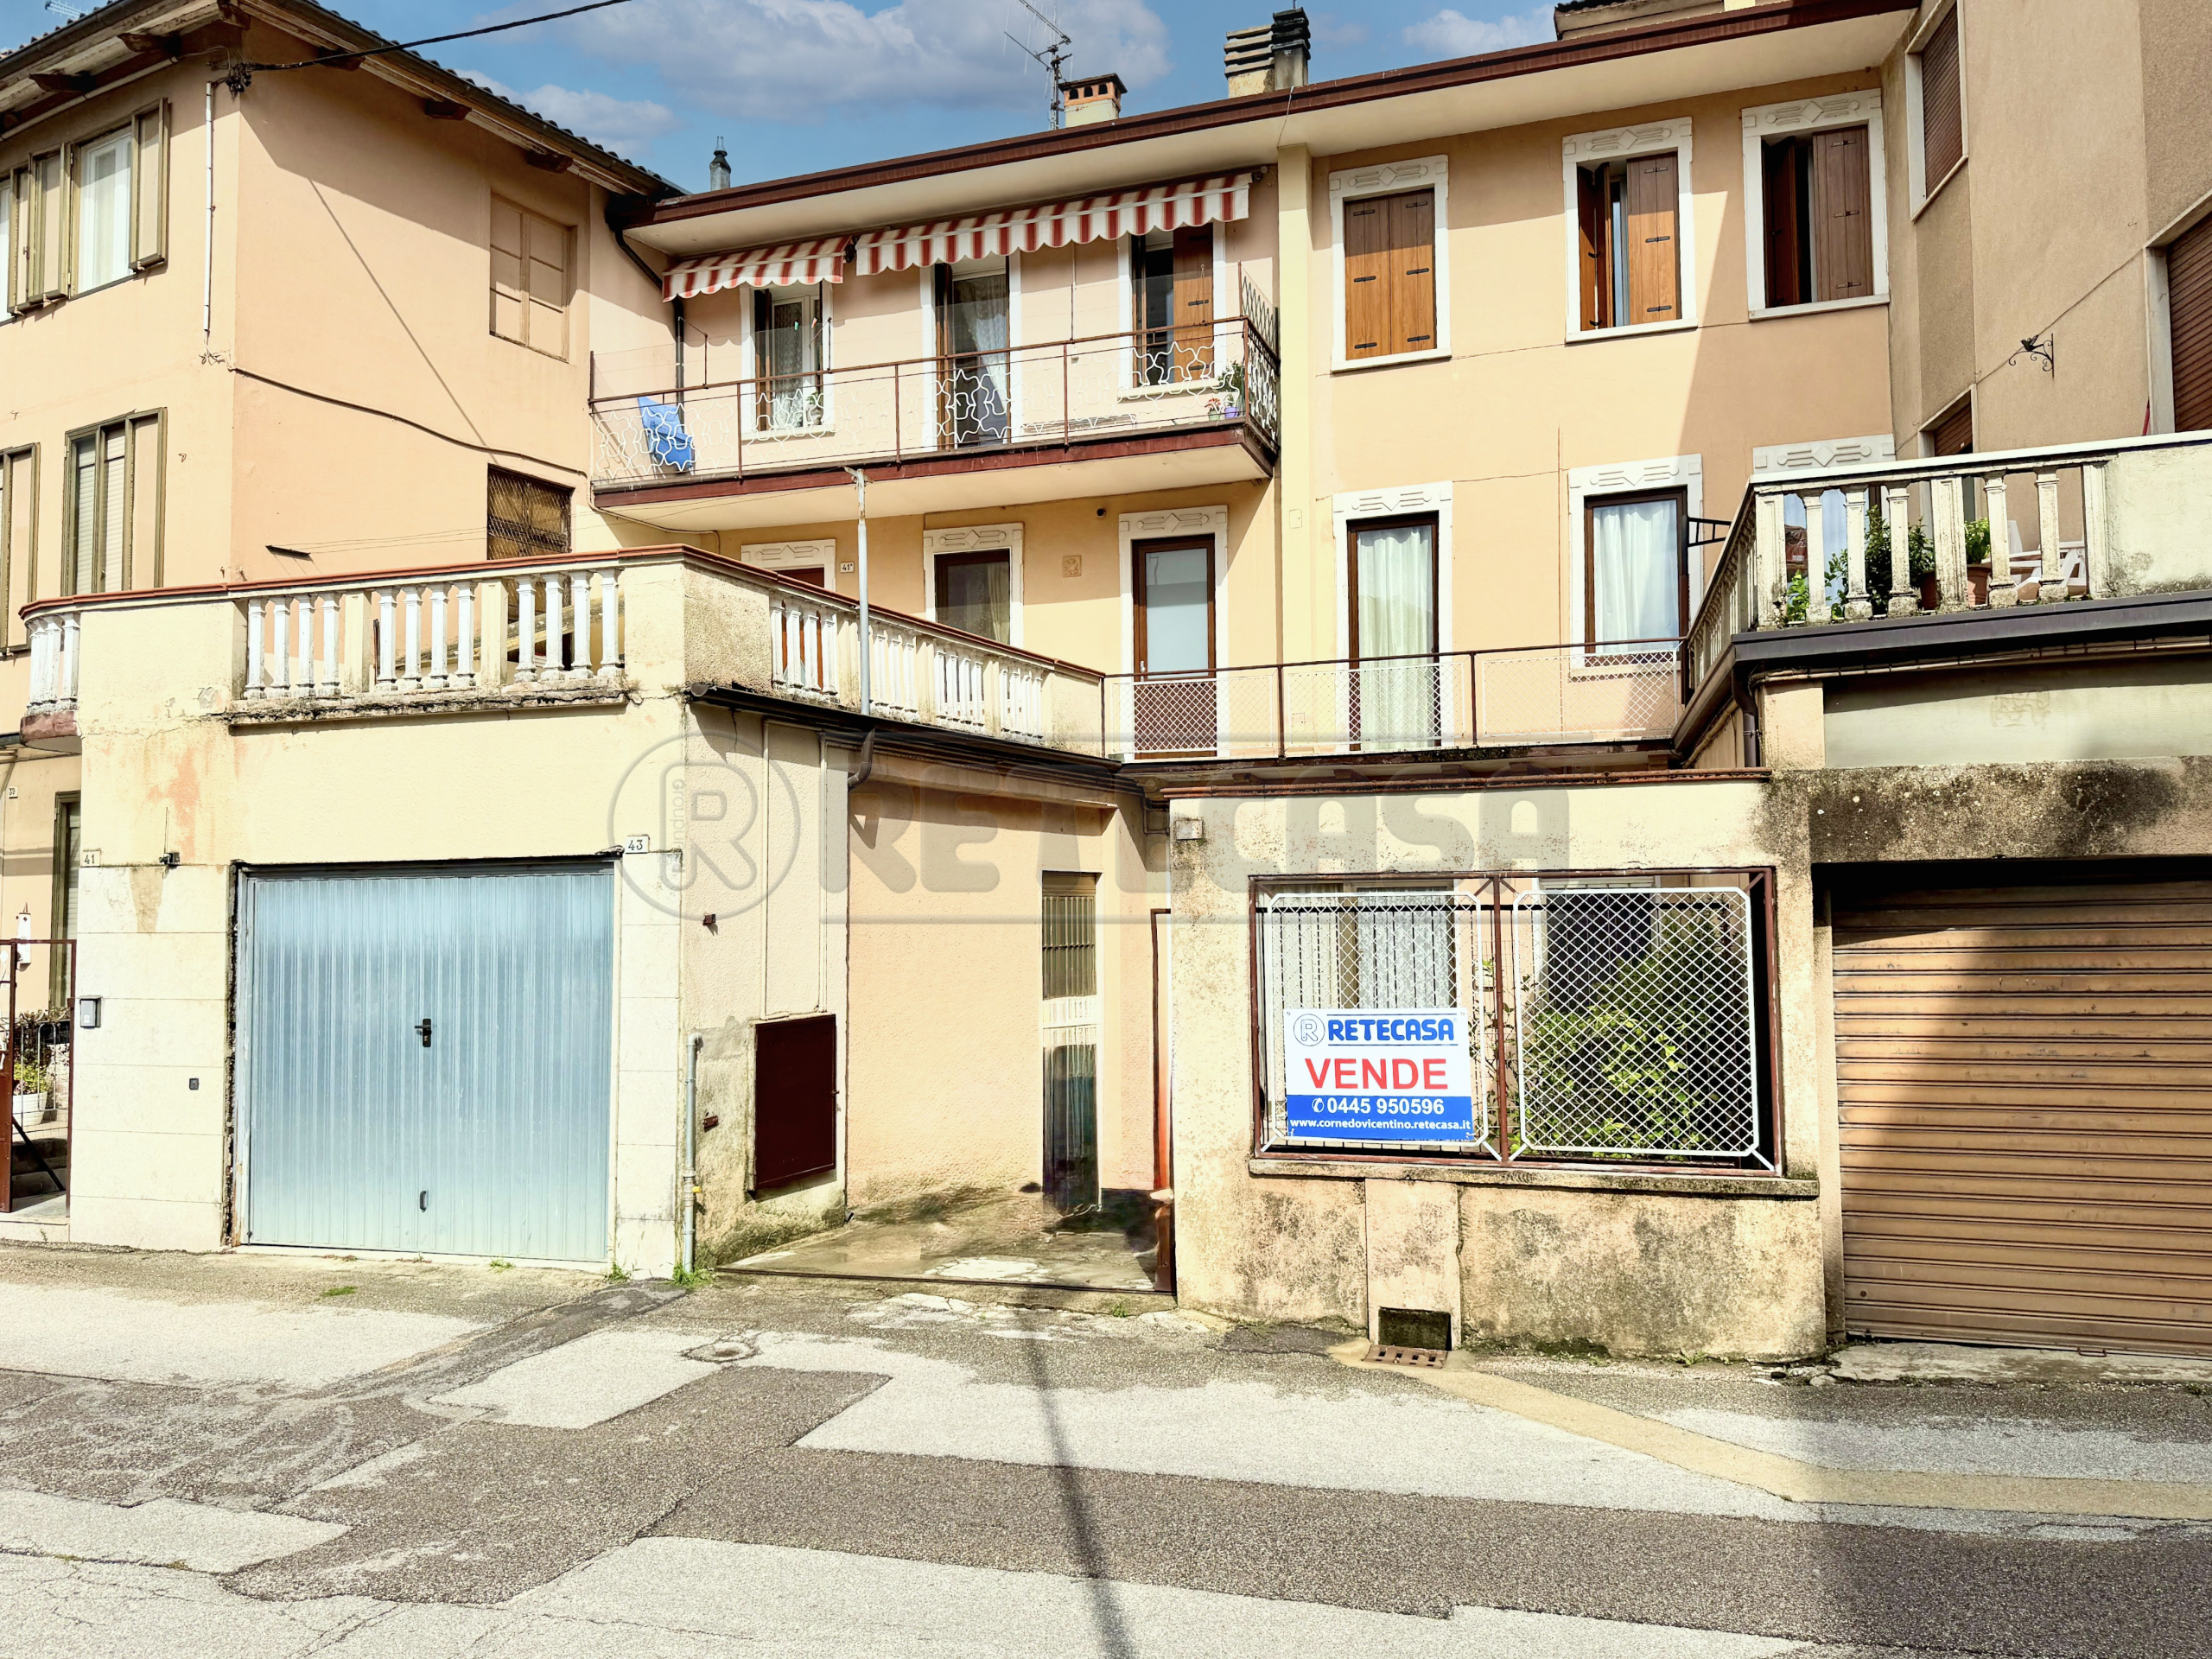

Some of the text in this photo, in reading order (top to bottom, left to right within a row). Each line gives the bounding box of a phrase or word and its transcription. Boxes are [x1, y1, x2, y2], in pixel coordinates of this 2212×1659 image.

[627, 839, 643, 851] 43
[84, 854, 95, 865] 41
[1328, 1018, 1455, 1042] RETECASA
[1305, 1058, 1448, 1090] VENDE
[1326, 1097, 1445, 1116] 0445 950596
[1290, 1117, 1471, 1130] www.cornedovicentino.retecasa.it
